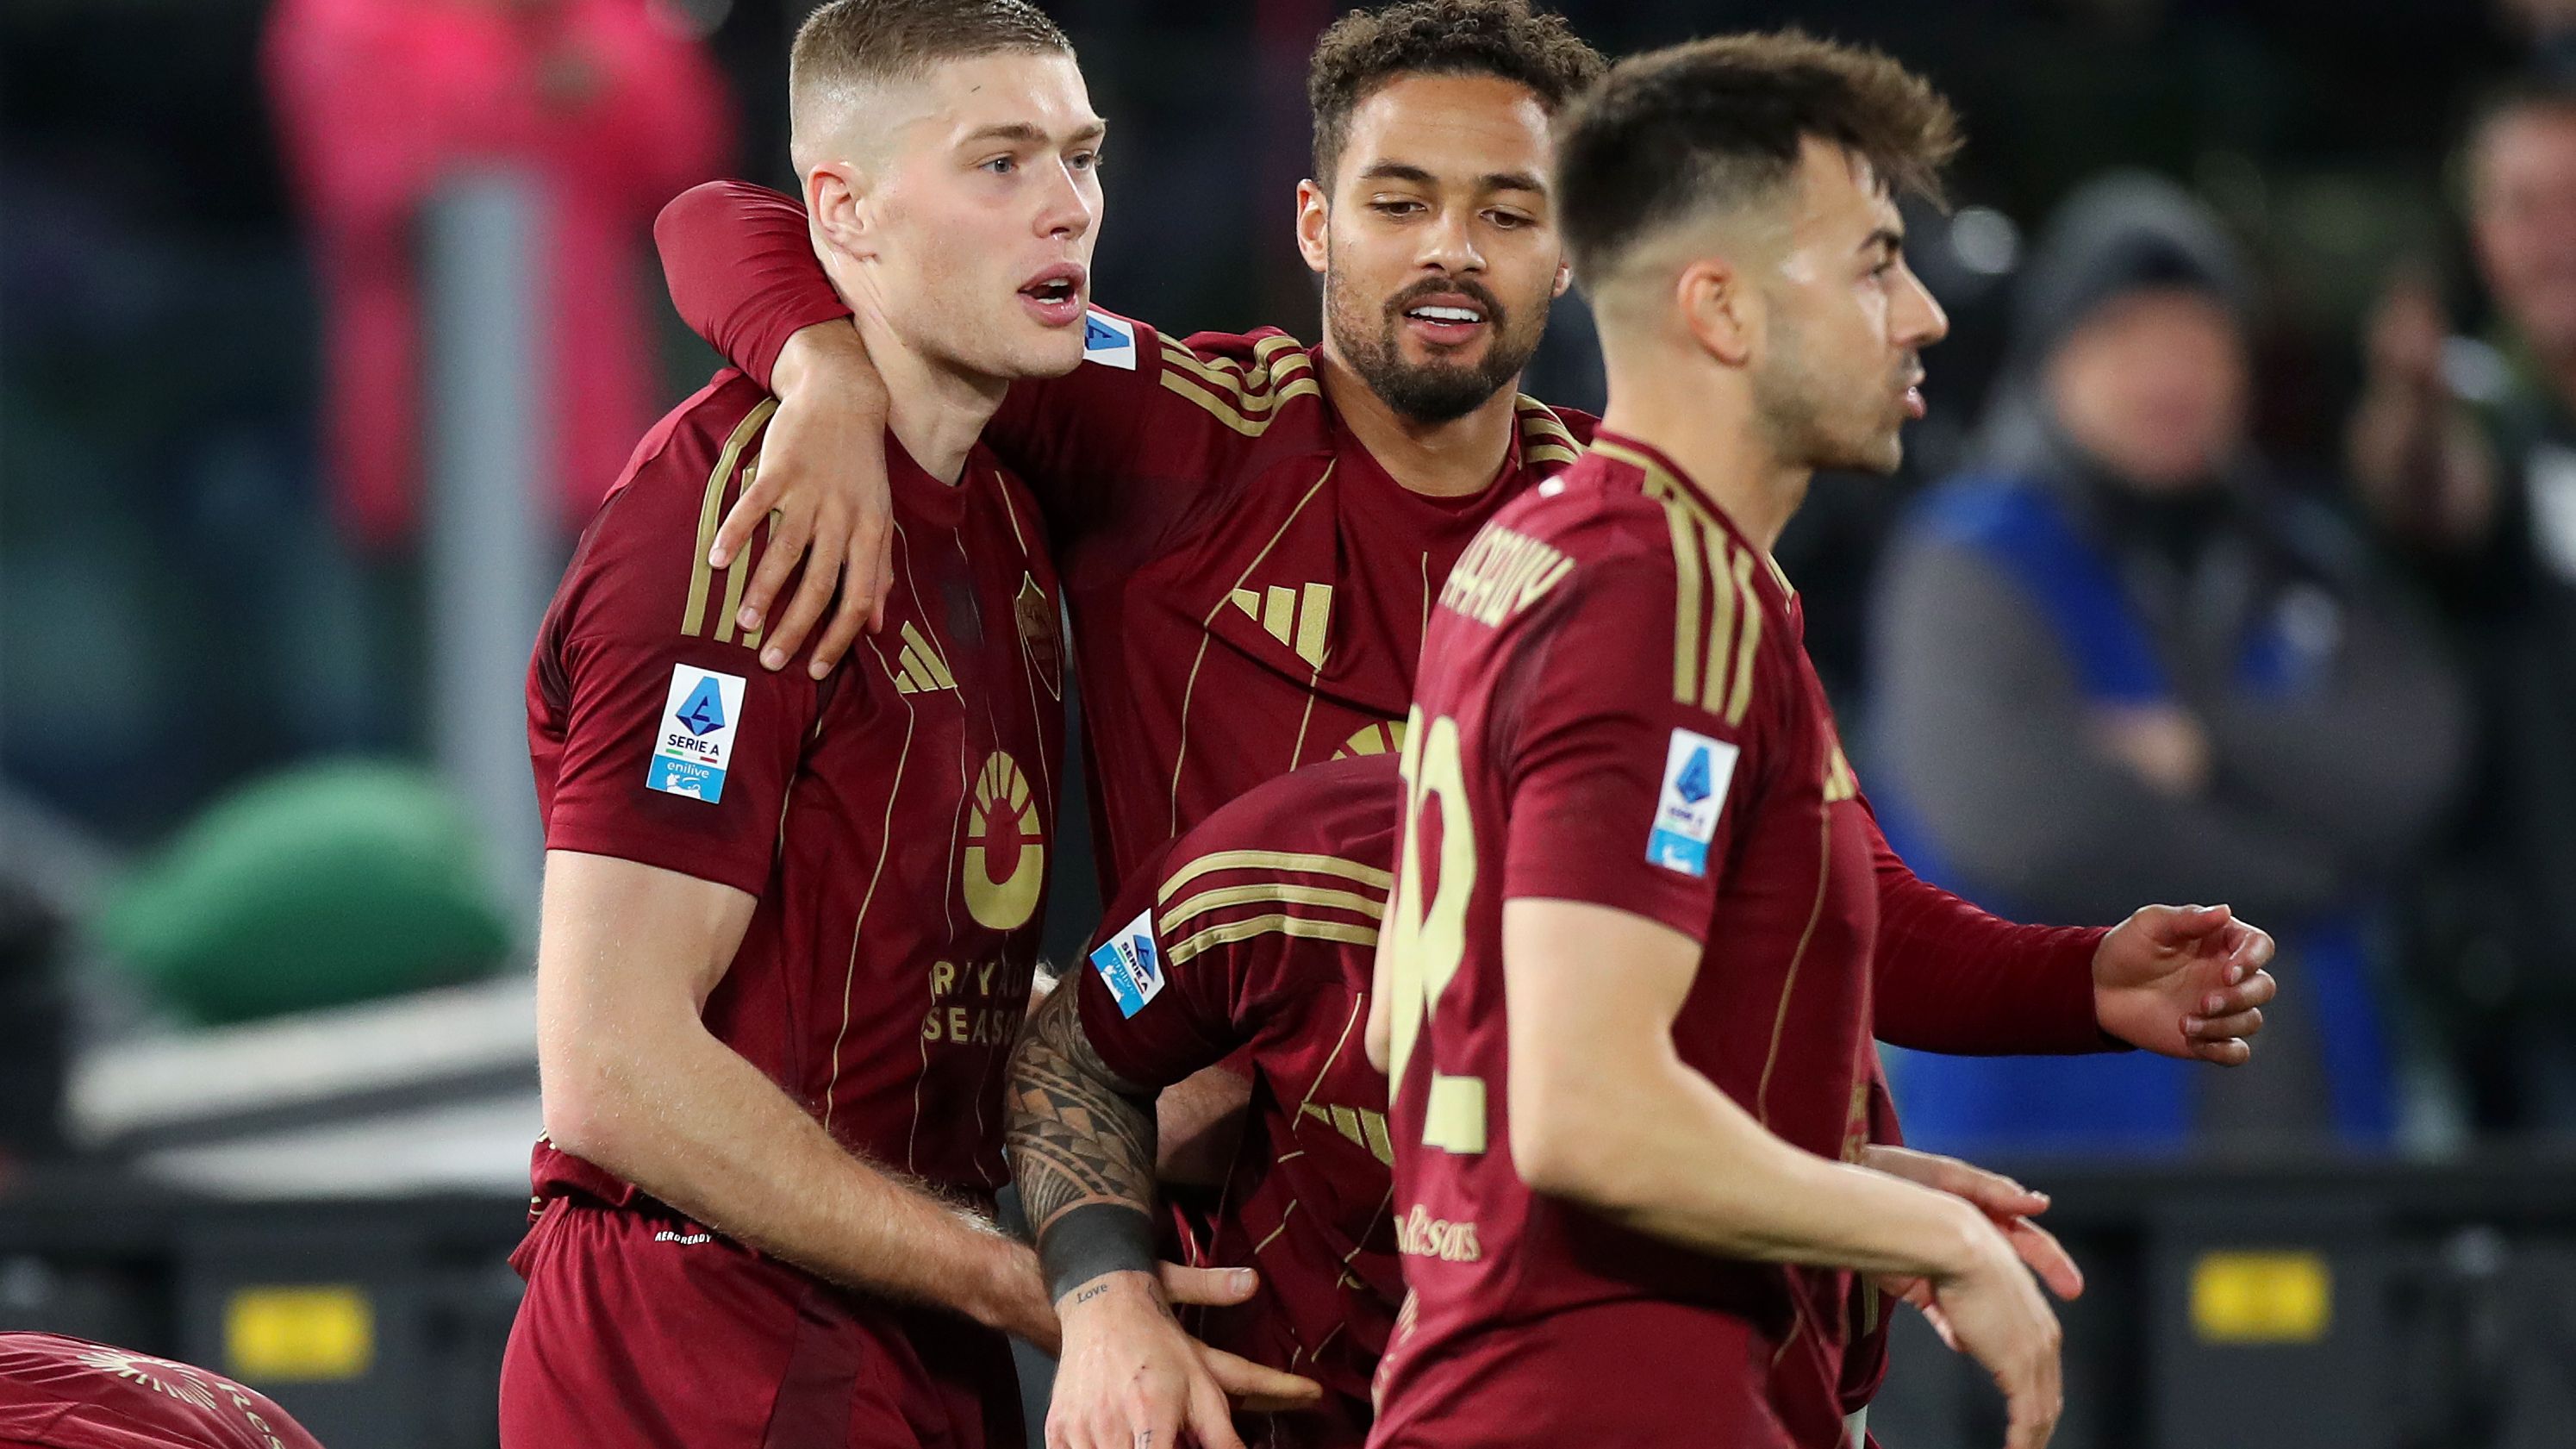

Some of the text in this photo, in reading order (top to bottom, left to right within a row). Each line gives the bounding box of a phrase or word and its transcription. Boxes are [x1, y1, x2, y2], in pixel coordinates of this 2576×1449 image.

[668, 734, 719, 756] SERIE A
[667, 760, 709, 778] enilive
[1120, 941, 1144, 979] SERIE
[923, 1006, 1019, 1046] SEASO
[654, 1231, 712, 1245] AEROREADY
[1076, 1283, 1108, 1304] Love
